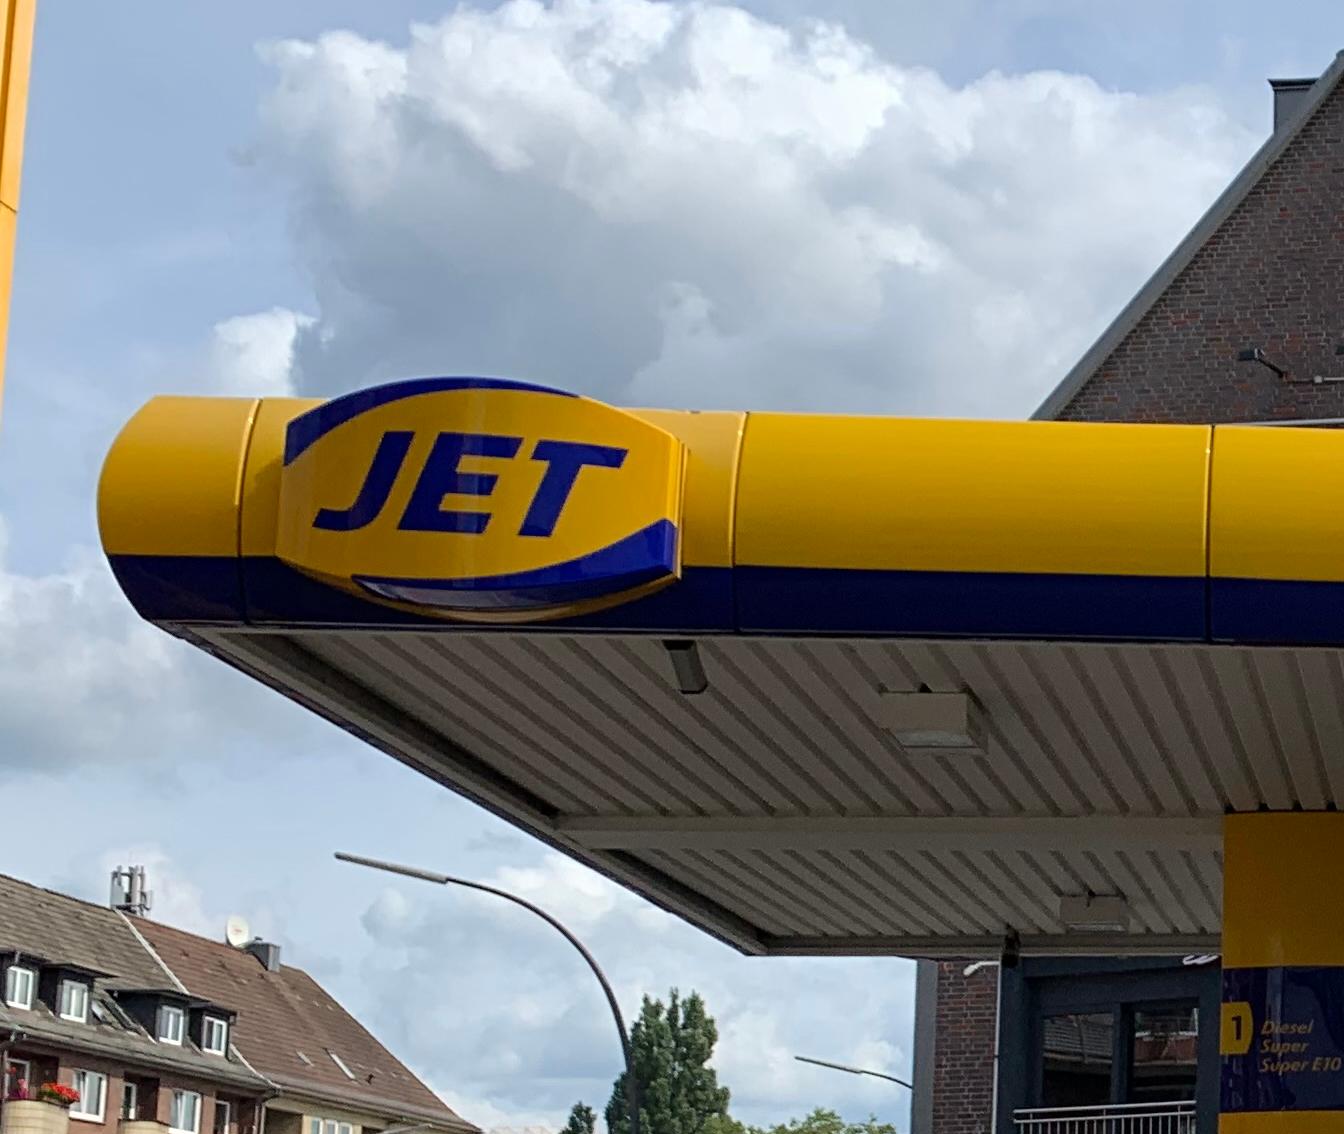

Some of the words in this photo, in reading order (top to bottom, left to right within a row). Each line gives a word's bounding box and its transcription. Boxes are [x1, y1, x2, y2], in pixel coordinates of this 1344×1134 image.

[312, 431, 629, 538] JET
[1231, 1015, 1242, 1041] 1
[1260, 1019, 1314, 1035] Diesel
[1260, 1039, 1309, 1056] Super
[1259, 1057, 1308, 1074] Super
[1311, 1056, 1342, 1073] E10
